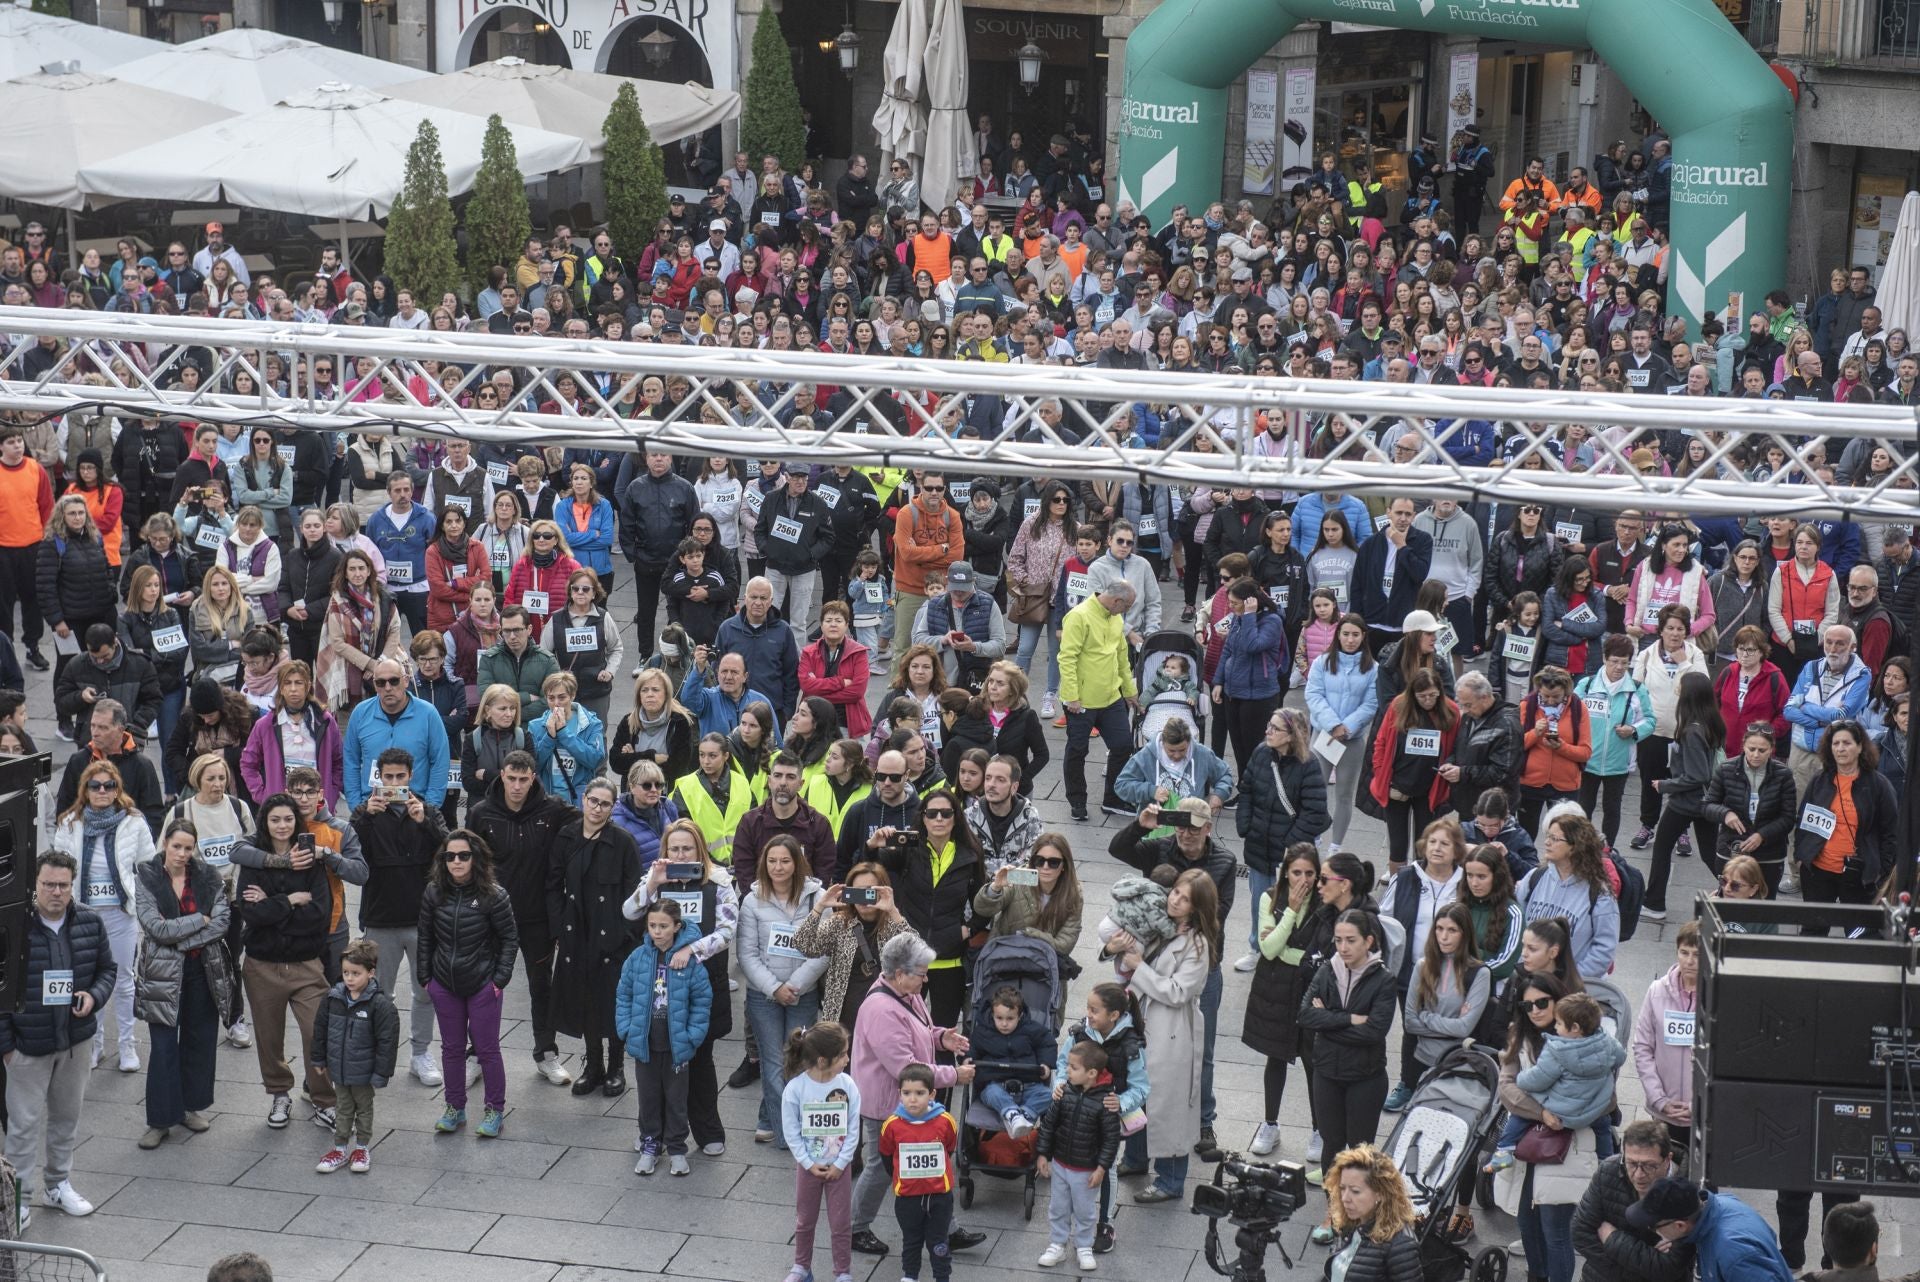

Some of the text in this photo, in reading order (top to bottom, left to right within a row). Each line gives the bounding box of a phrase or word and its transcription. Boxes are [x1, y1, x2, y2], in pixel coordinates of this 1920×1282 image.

[1449, 5, 1539, 27] Fundación
[975, 19, 1080, 39] SOUVENIR
[573, 30, 593, 50] DE
[488, 469, 505, 481] 6071
[716, 492, 735, 503] 2328
[779, 522, 797, 537] 2560
[202, 532, 223, 548] 4715
[388, 566, 408, 578] 2272
[530, 597, 541, 608] 20
[157, 632, 181, 648] 6673
[570, 634, 593, 646] 4699
[1509, 643, 1528, 655] 1100
[1411, 738, 1434, 749] 4614
[1806, 813, 1832, 830] 6110
[87, 883, 116, 896] 6348
[48, 981, 74, 994] 678
[808, 1112, 841, 1128] 1396
[905, 1153, 940, 1169] 1395
